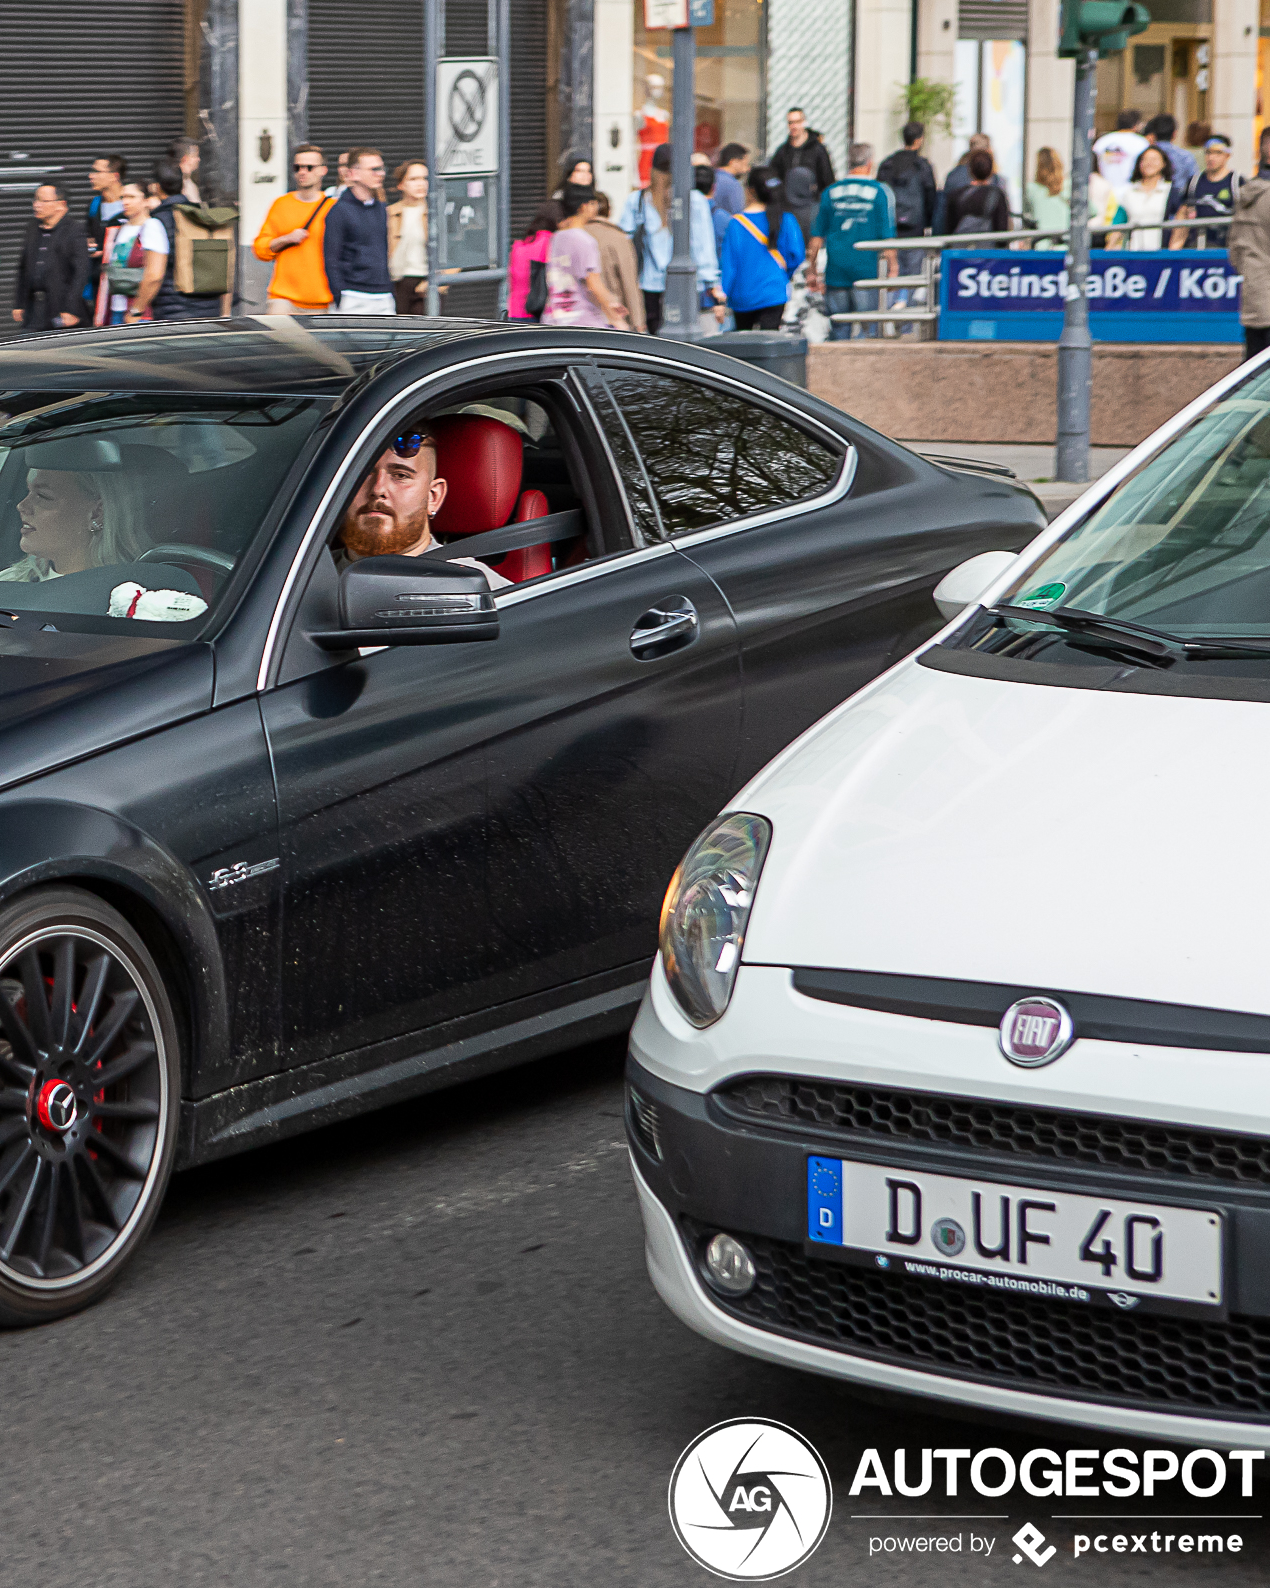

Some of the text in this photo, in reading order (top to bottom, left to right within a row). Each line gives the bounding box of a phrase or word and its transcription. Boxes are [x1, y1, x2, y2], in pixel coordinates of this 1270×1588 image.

[958, 266, 1147, 298] Steinstaße
[1153, 268, 1172, 298] /
[1013, 1013, 1058, 1048] FIAT
[819, 1207, 835, 1228] D
[885, 1176, 1164, 1283] D UF 40
[904, 1259, 1090, 1301] www.procar-automobile.de
